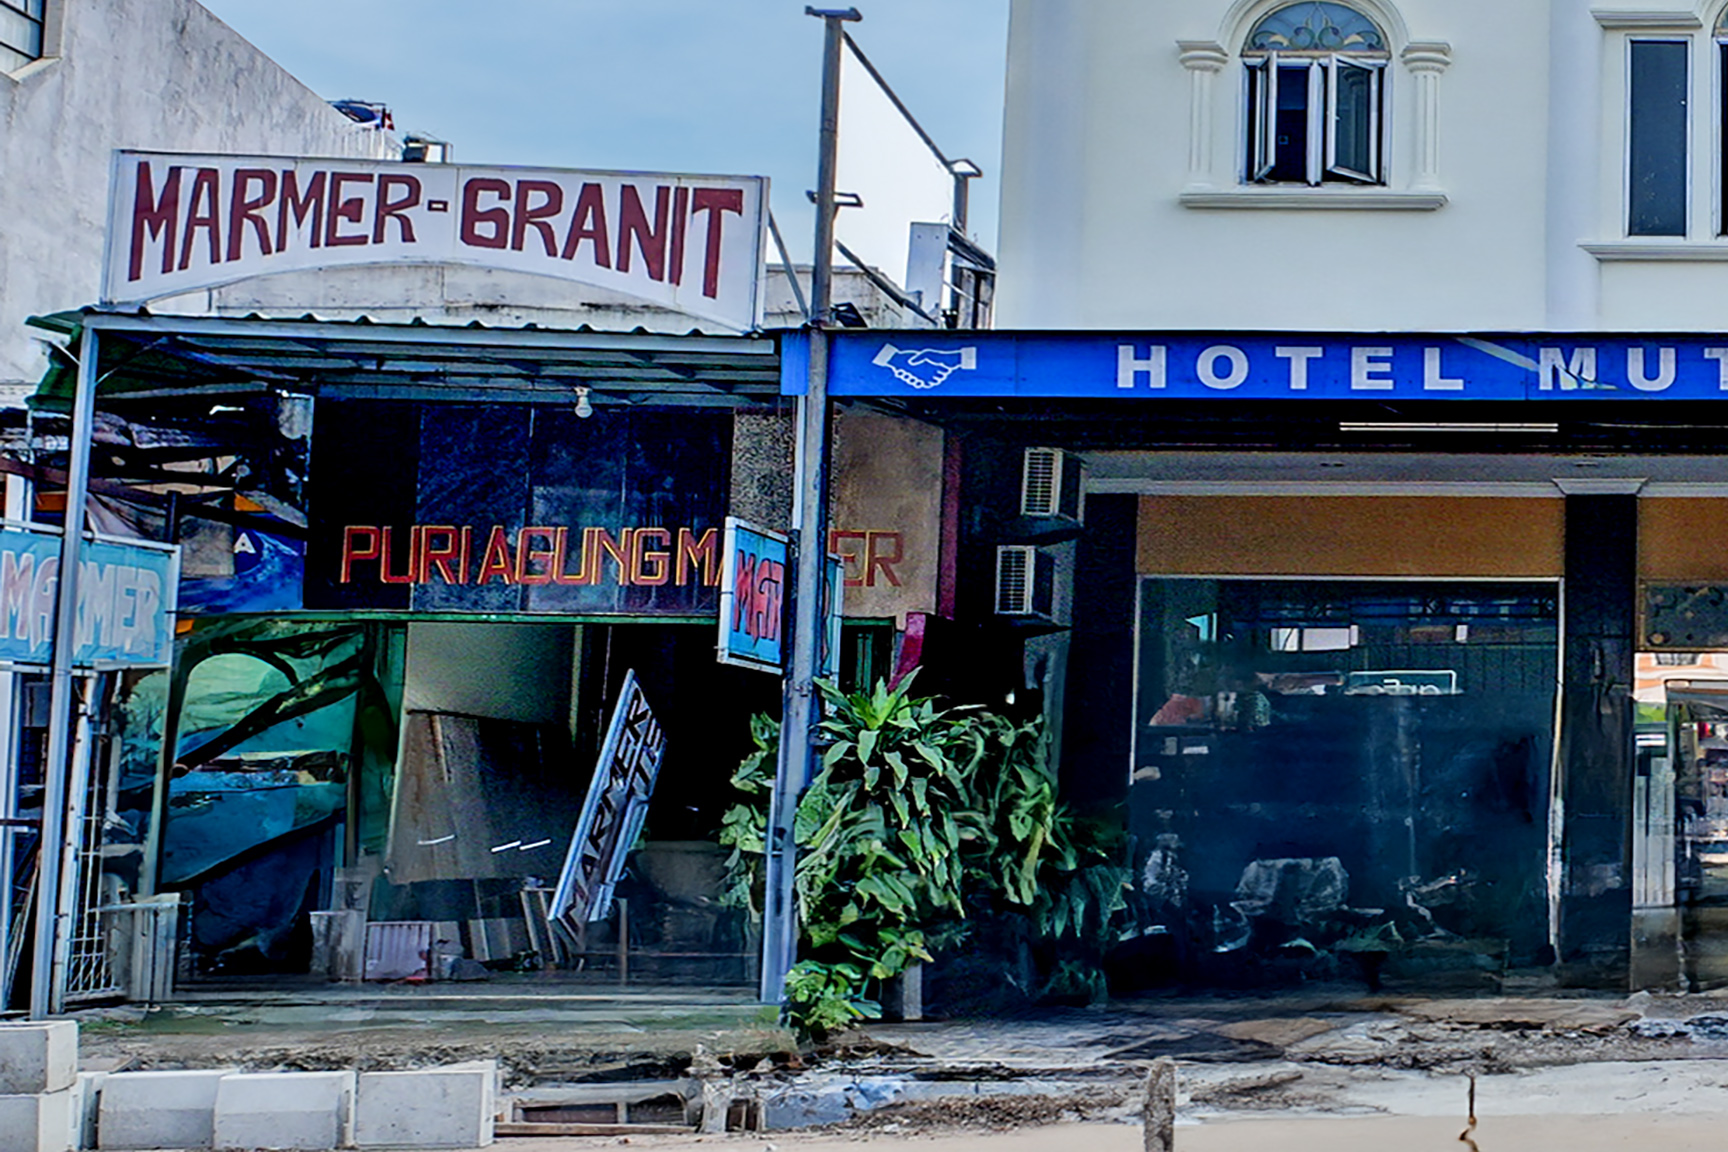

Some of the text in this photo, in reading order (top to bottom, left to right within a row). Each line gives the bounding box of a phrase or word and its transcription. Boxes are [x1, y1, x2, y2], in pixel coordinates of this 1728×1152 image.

[1117, 344, 1465, 392] HOTEL
[339, 525, 470, 584] PURI
[477, 525, 671, 586] AGUNG
